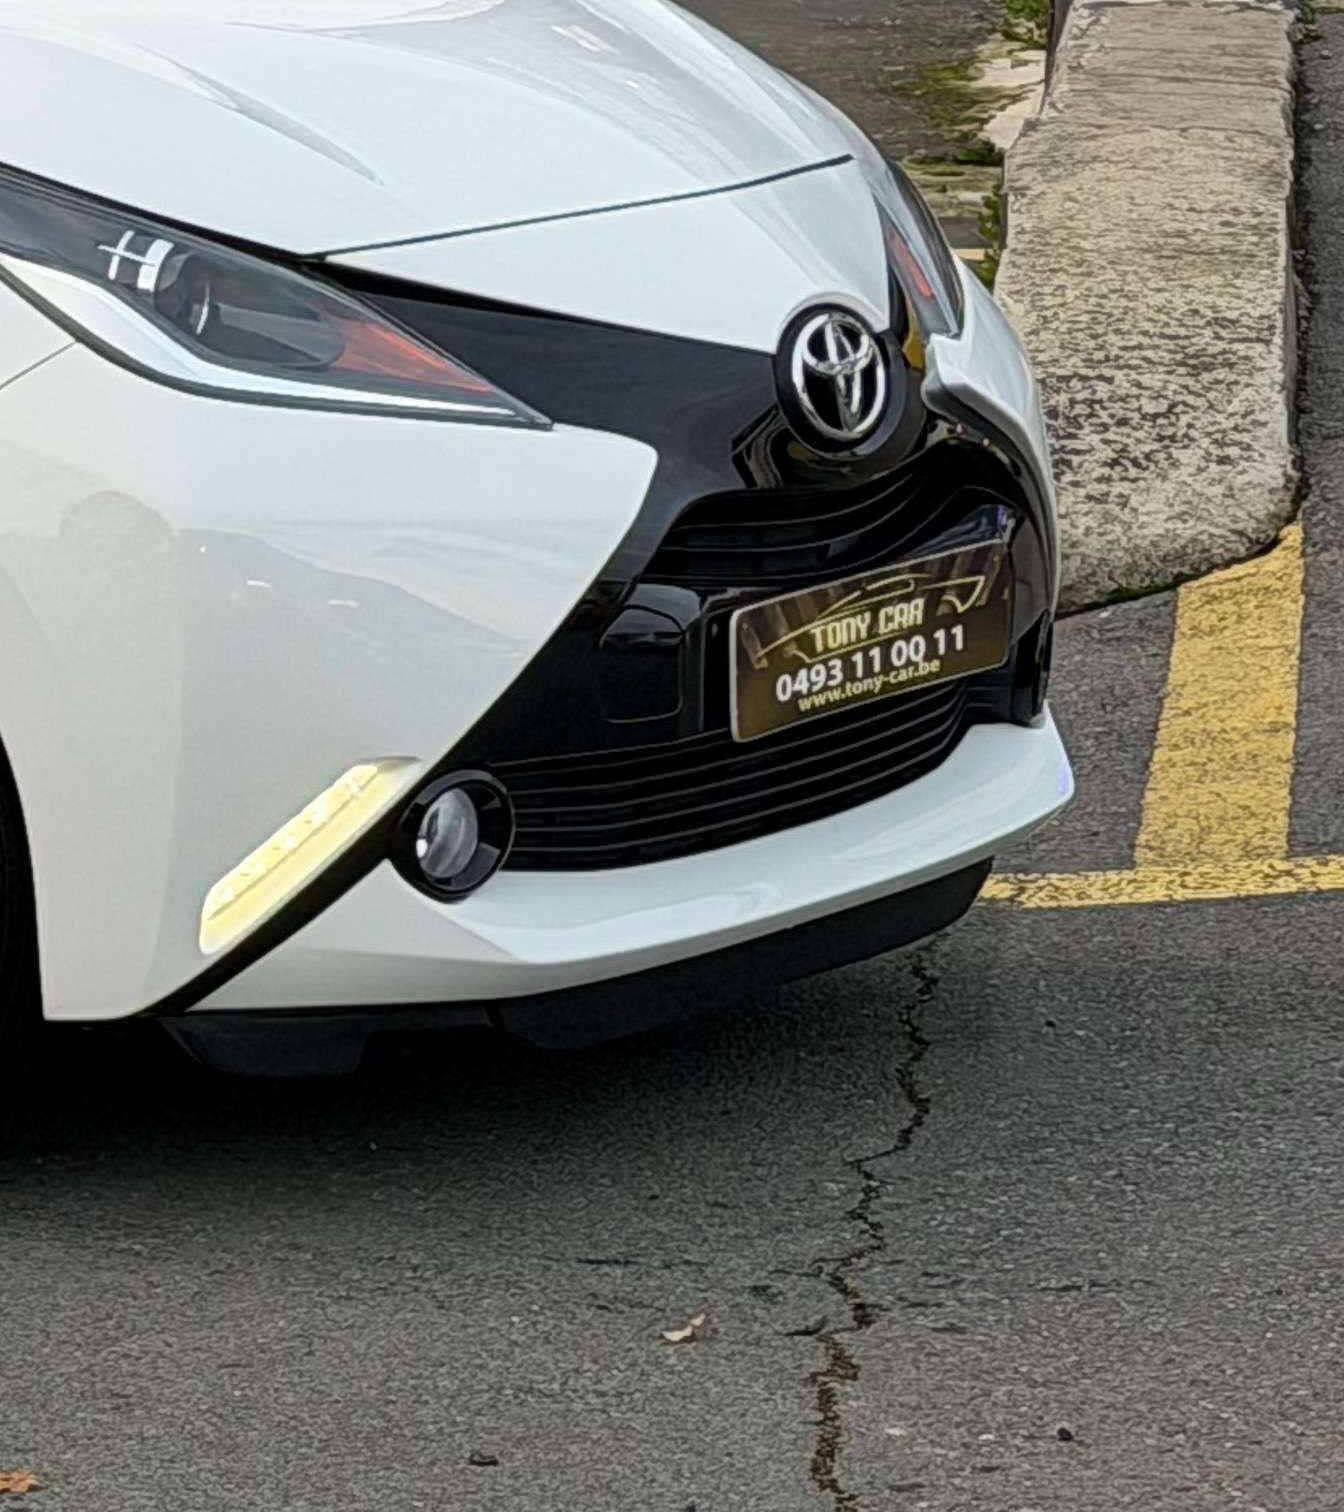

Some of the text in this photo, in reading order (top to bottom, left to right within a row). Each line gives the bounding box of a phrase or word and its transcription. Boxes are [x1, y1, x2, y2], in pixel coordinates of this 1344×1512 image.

[811, 597, 926, 653] TONY CAR
[775, 624, 965, 702] 0493 11 00 11
[798, 657, 941, 713] www.tony-car.be
